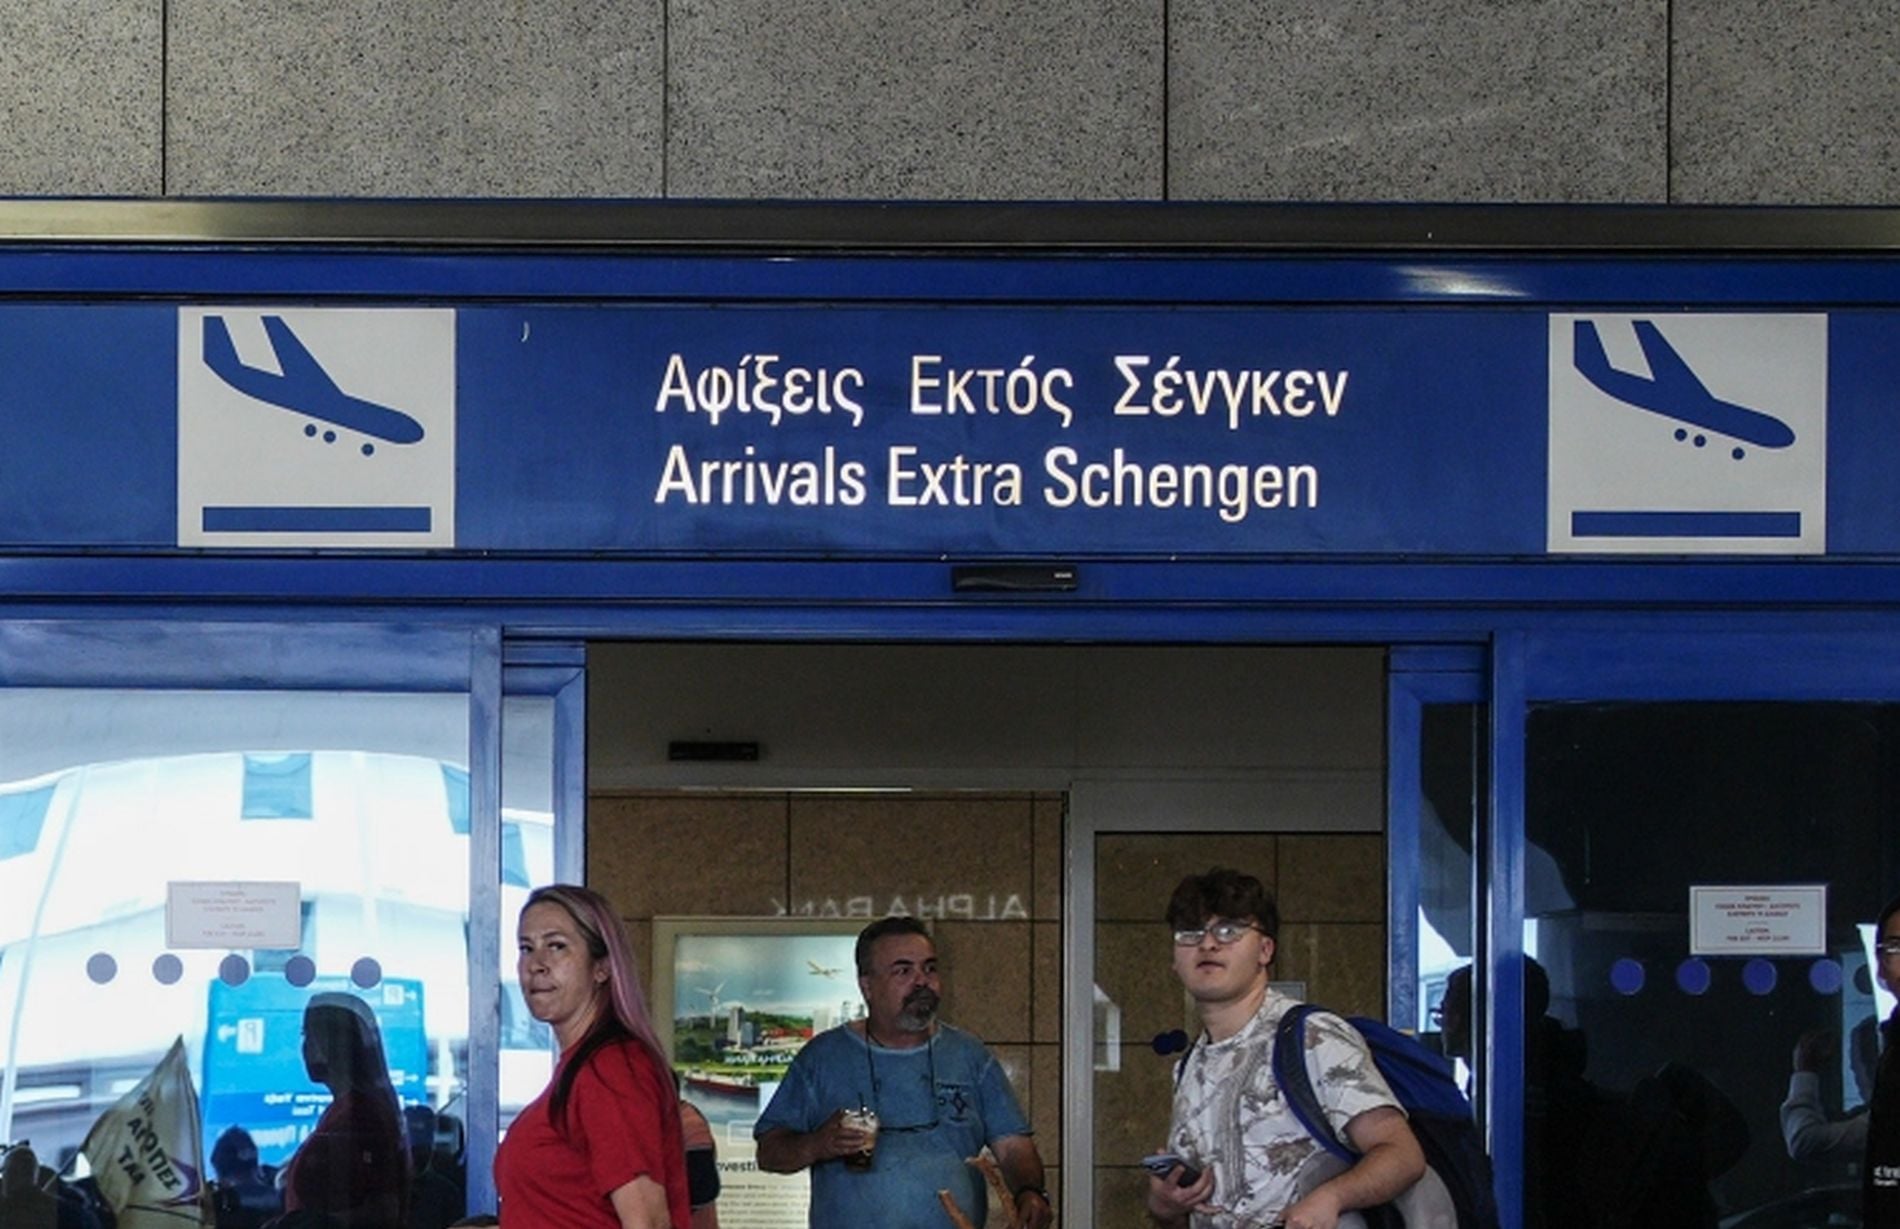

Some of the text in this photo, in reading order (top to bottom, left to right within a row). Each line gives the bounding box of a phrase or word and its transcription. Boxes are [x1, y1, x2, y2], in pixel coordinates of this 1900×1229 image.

[655, 354, 1349, 430] Αφίξεις Εκτός Σένγκεν
[655, 445, 1318, 523] Arrivals Extra Schengen
